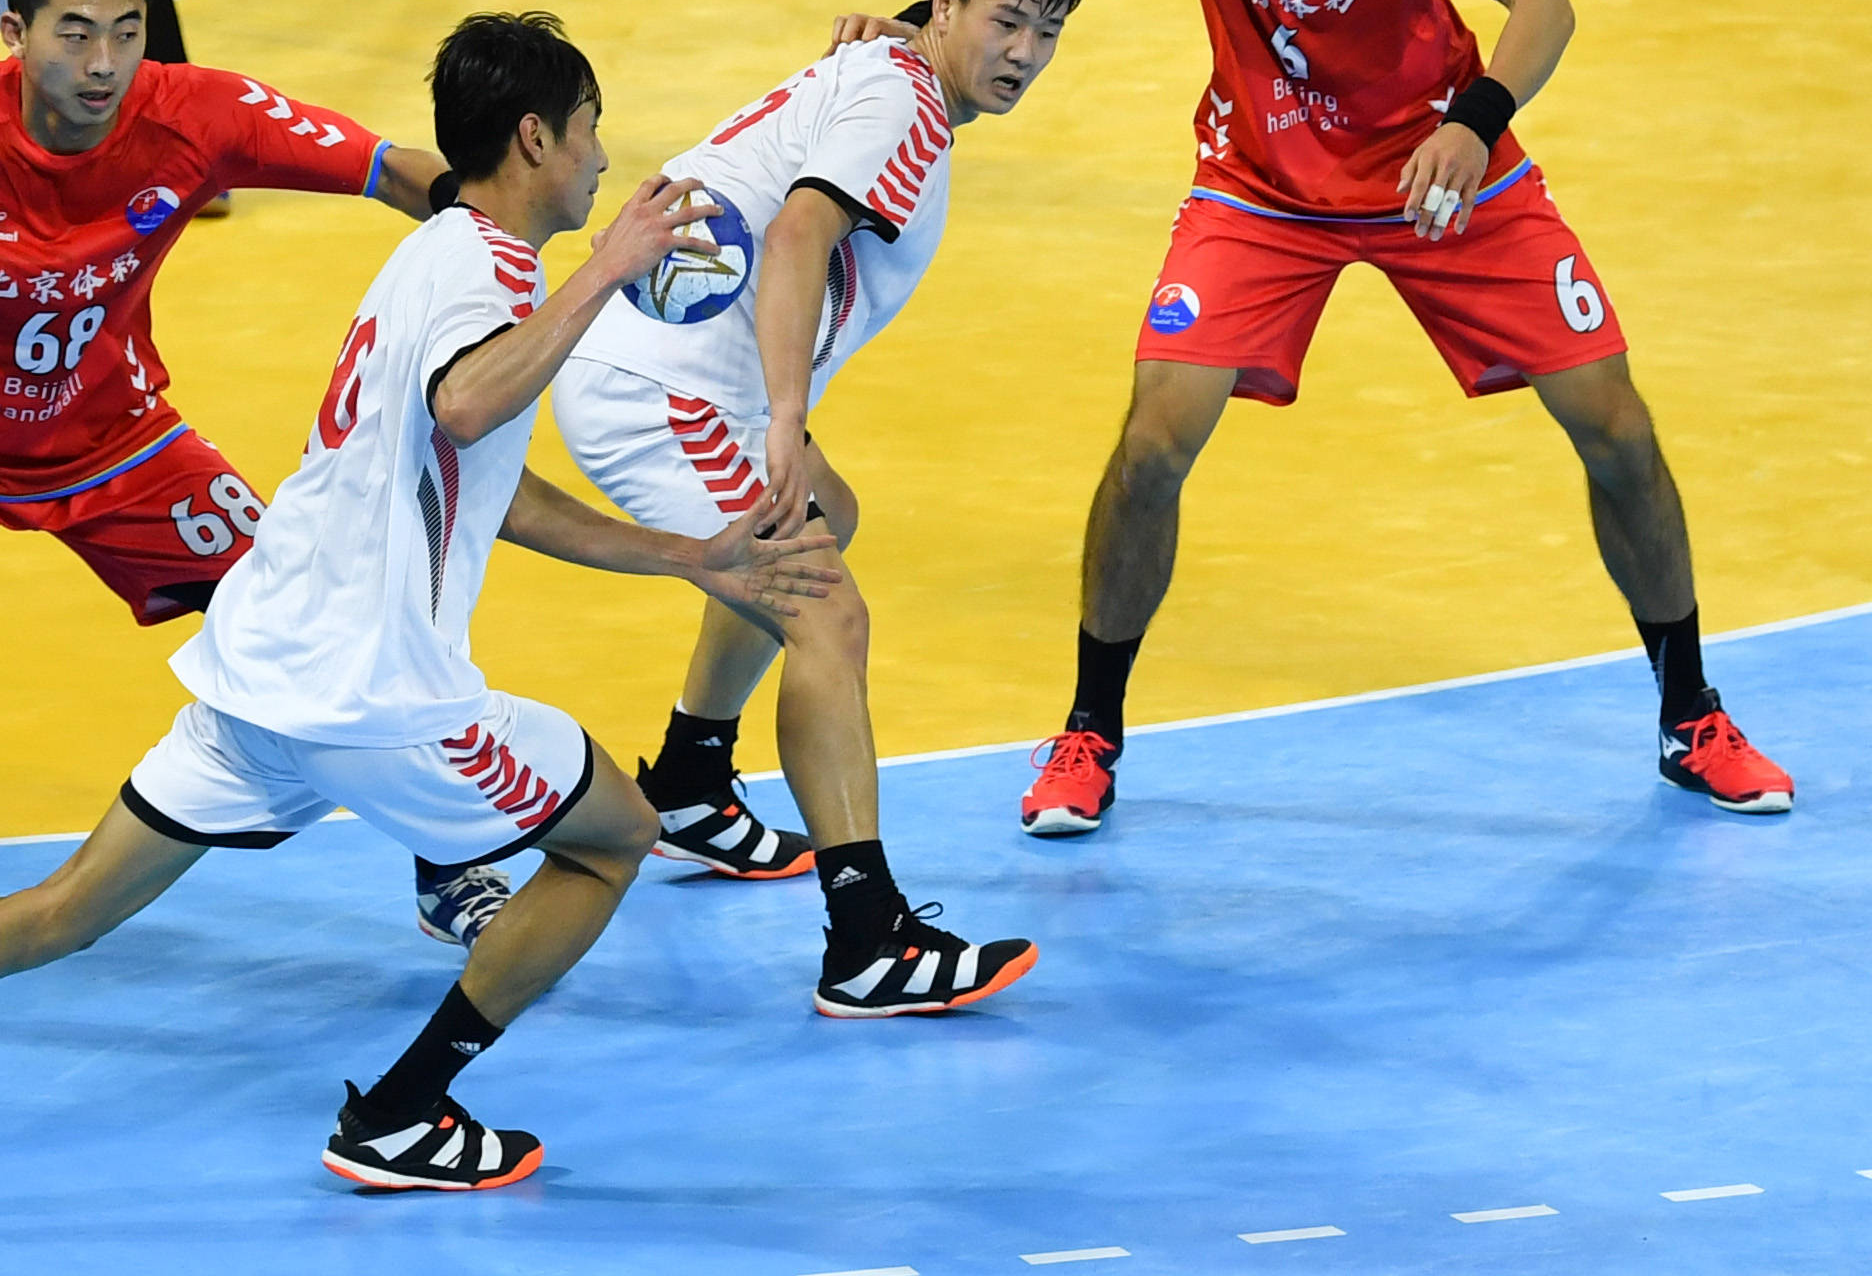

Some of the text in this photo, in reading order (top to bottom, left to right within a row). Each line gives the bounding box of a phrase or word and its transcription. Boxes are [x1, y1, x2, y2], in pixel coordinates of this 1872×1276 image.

[1270, 23, 1309, 80] 6
[1273, 77, 1337, 112] Being
[1554, 253, 1606, 334] 6
[14, 304, 106, 375] 68
[169, 471, 268, 557] 68
